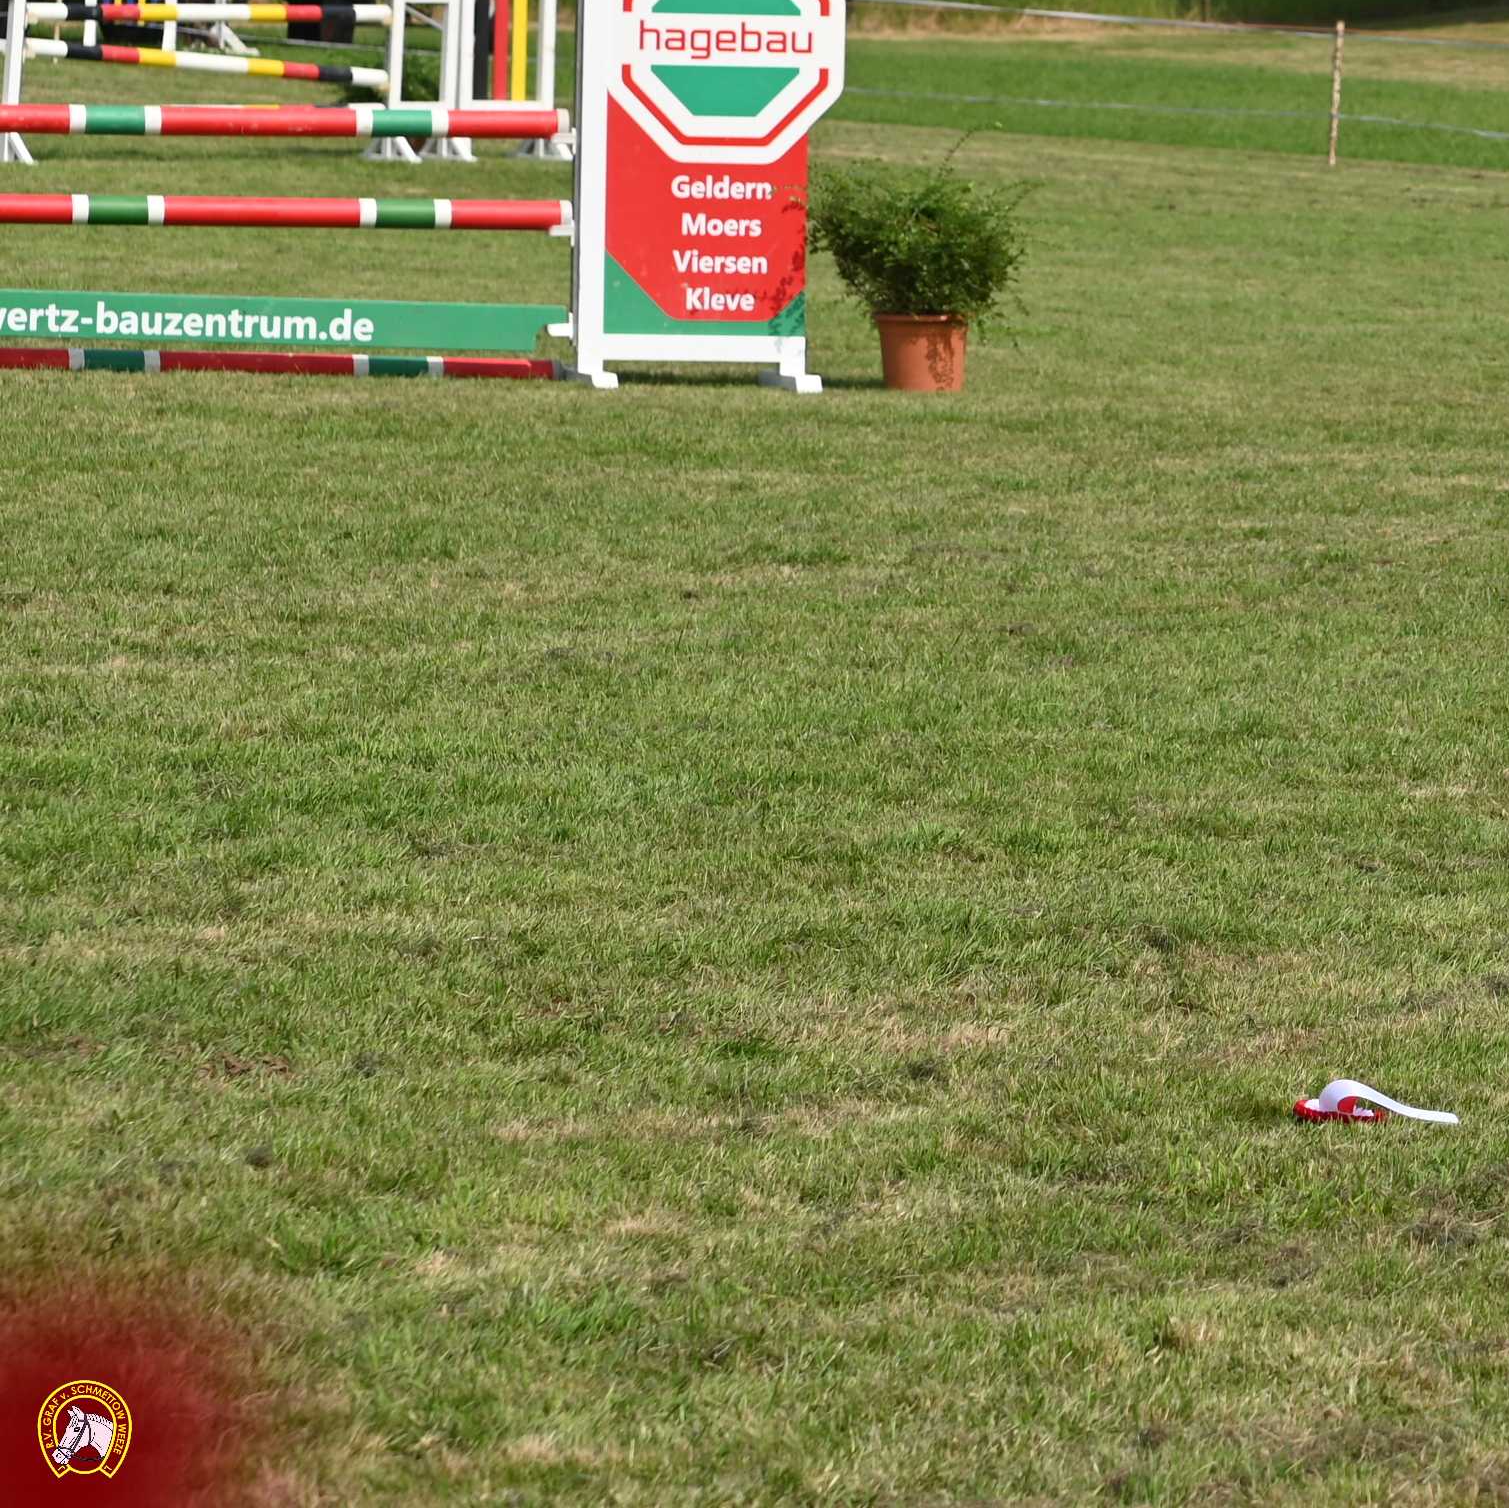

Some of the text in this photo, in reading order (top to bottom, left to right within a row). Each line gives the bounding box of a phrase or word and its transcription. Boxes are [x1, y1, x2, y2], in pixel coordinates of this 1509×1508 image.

[639, 19, 812, 59] hagebau
[671, 175, 772, 199] Geldern
[681, 212, 762, 237] Moers
[672, 249, 767, 275] Viersen
[685, 286, 756, 311] Kleve
